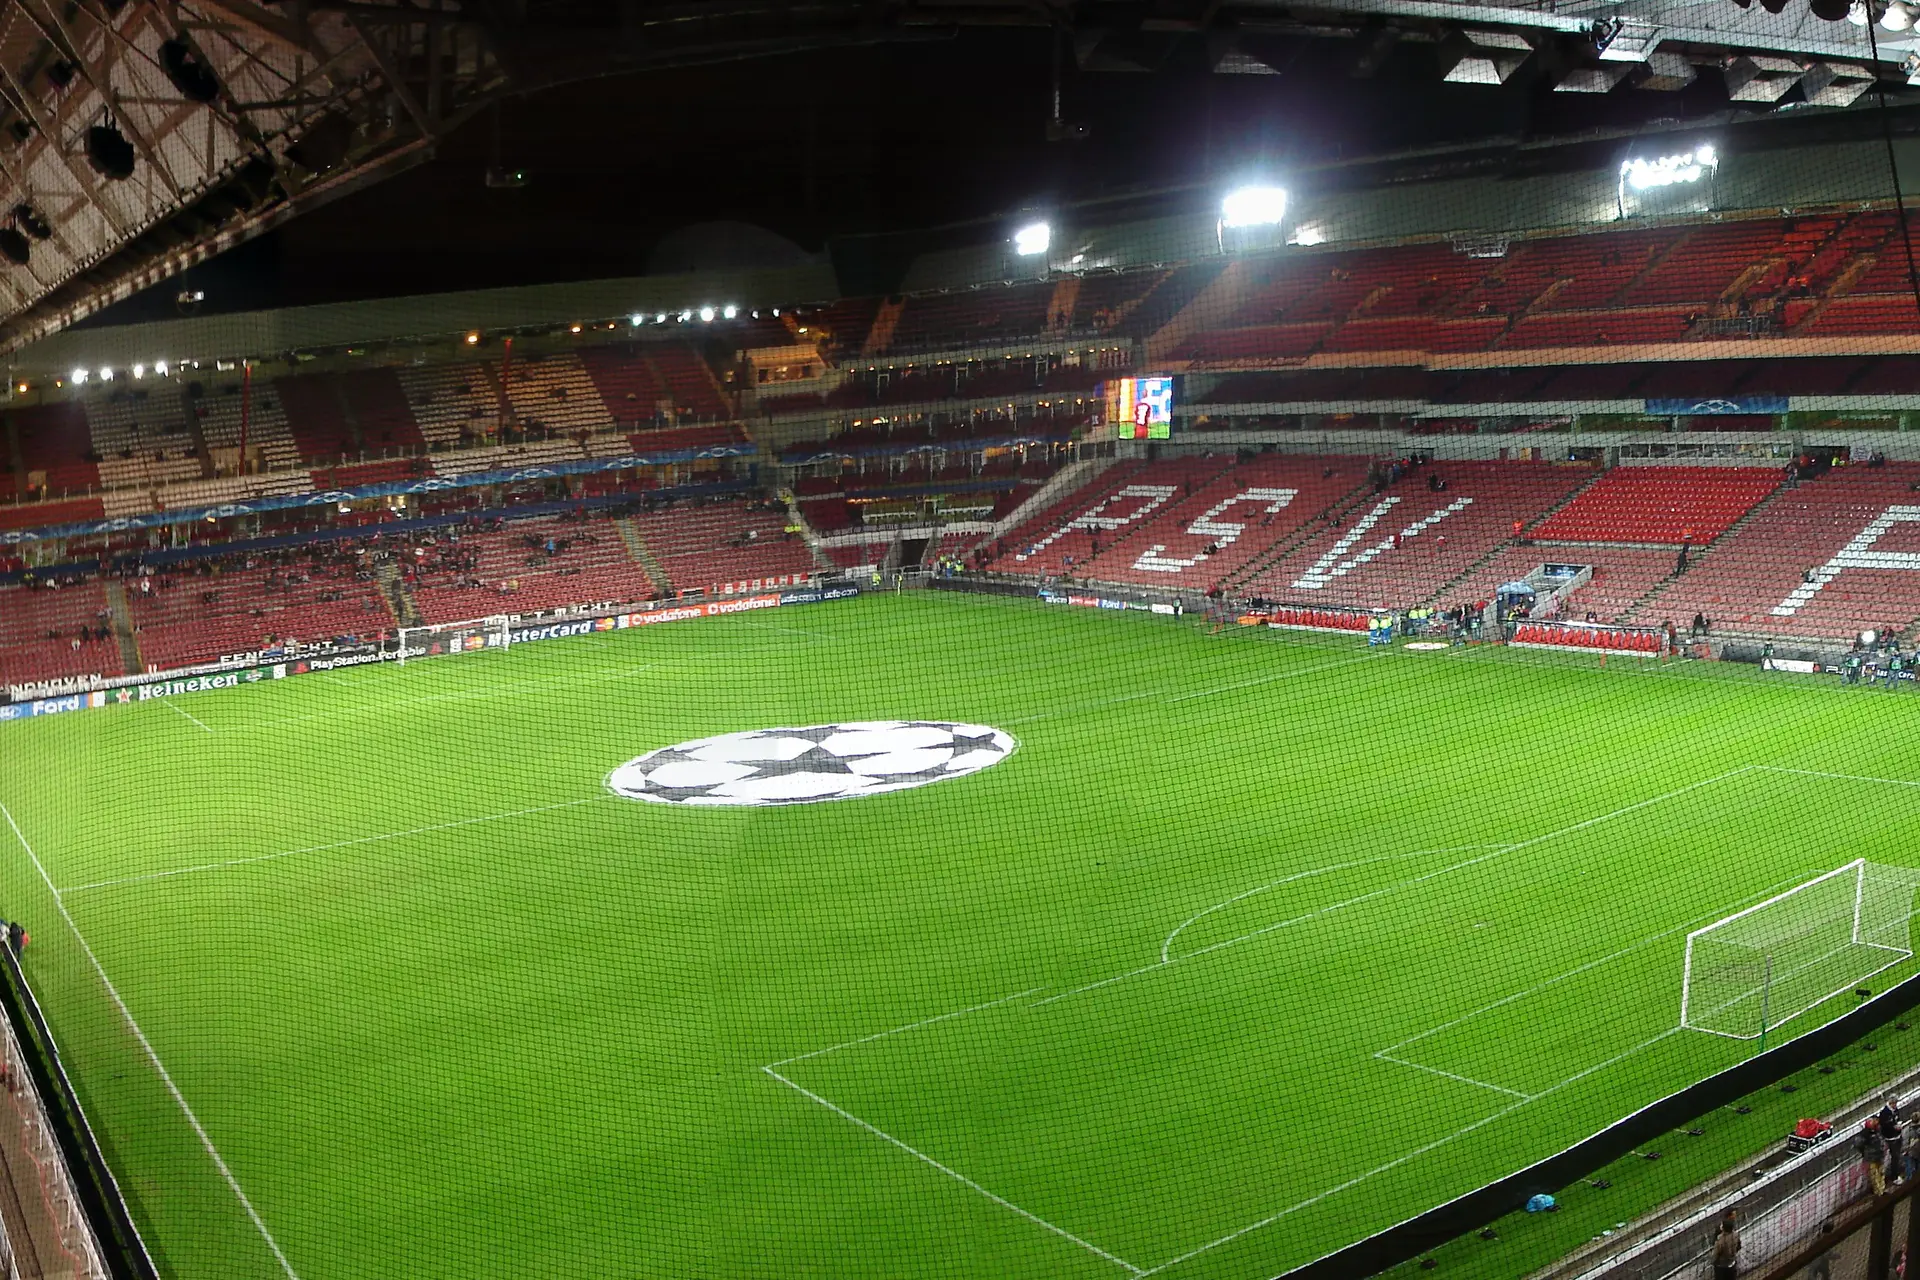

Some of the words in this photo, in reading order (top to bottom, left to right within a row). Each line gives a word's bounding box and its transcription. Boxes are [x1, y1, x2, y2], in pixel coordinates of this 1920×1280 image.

[643, 606, 702, 623] vodafone
[719, 598, 777, 614] vodafone
[138, 671, 239, 701] Heineken
[32, 695, 80, 716] Ford
